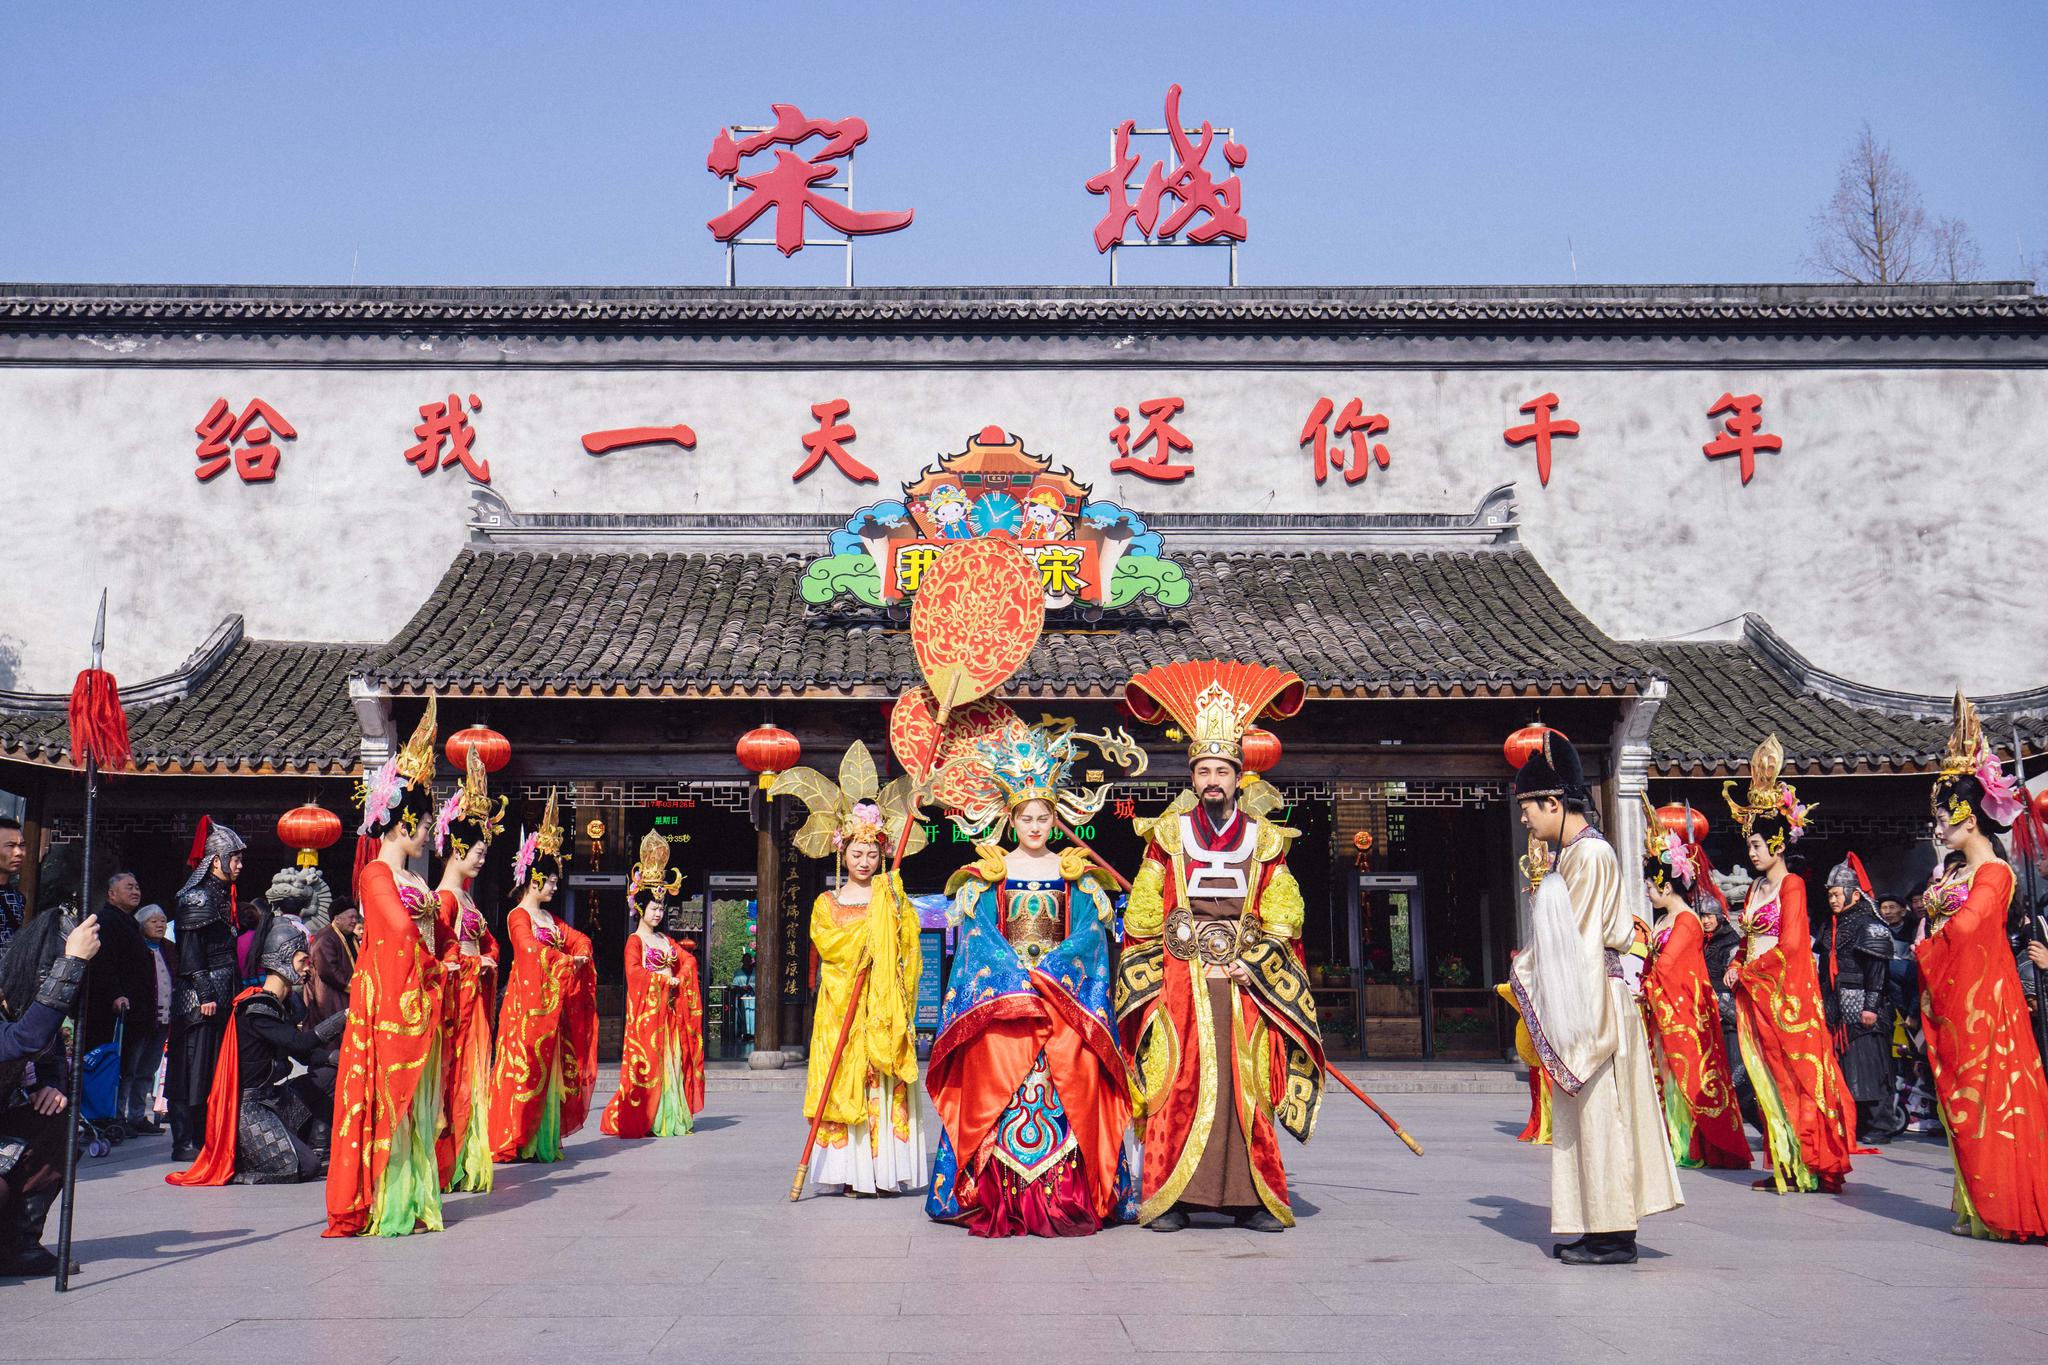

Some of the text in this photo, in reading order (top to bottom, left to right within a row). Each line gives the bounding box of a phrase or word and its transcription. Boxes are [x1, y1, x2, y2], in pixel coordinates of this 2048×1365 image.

[706, 83, 1248, 257] 宋城
[655, 815, 679, 825] 星期日
